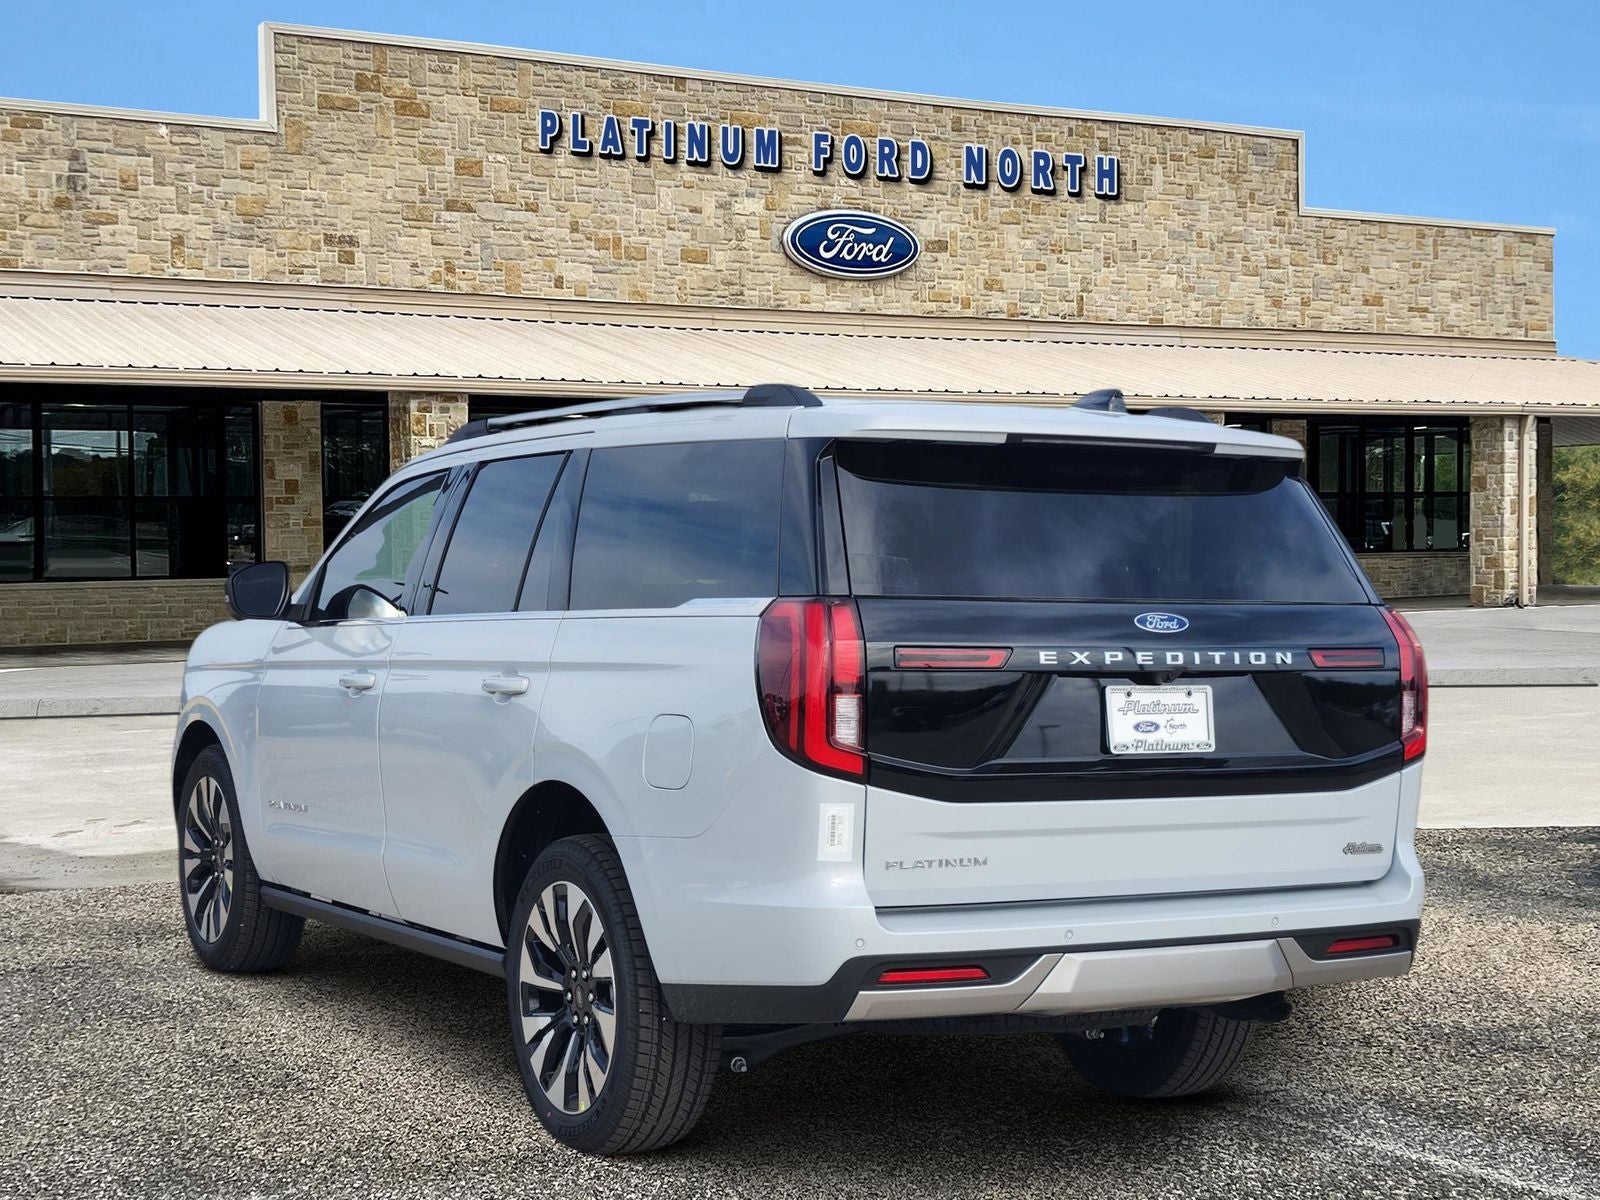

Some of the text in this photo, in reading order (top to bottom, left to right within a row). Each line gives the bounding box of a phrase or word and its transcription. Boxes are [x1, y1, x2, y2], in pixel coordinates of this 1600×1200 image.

[538, 110, 1120, 198] PLATINUM FORD NORTH
[819, 223, 895, 263] Ford
[1146, 615, 1180, 630] Ford
[1038, 651, 1293, 665] EXPEDITION
[1117, 700, 1199, 715] Platinum
[1137, 722, 1157, 733] Ford
[1169, 720, 1188, 730] North
[1134, 738, 1194, 752] Platinum
[884, 857, 988, 871] PLATINUM
